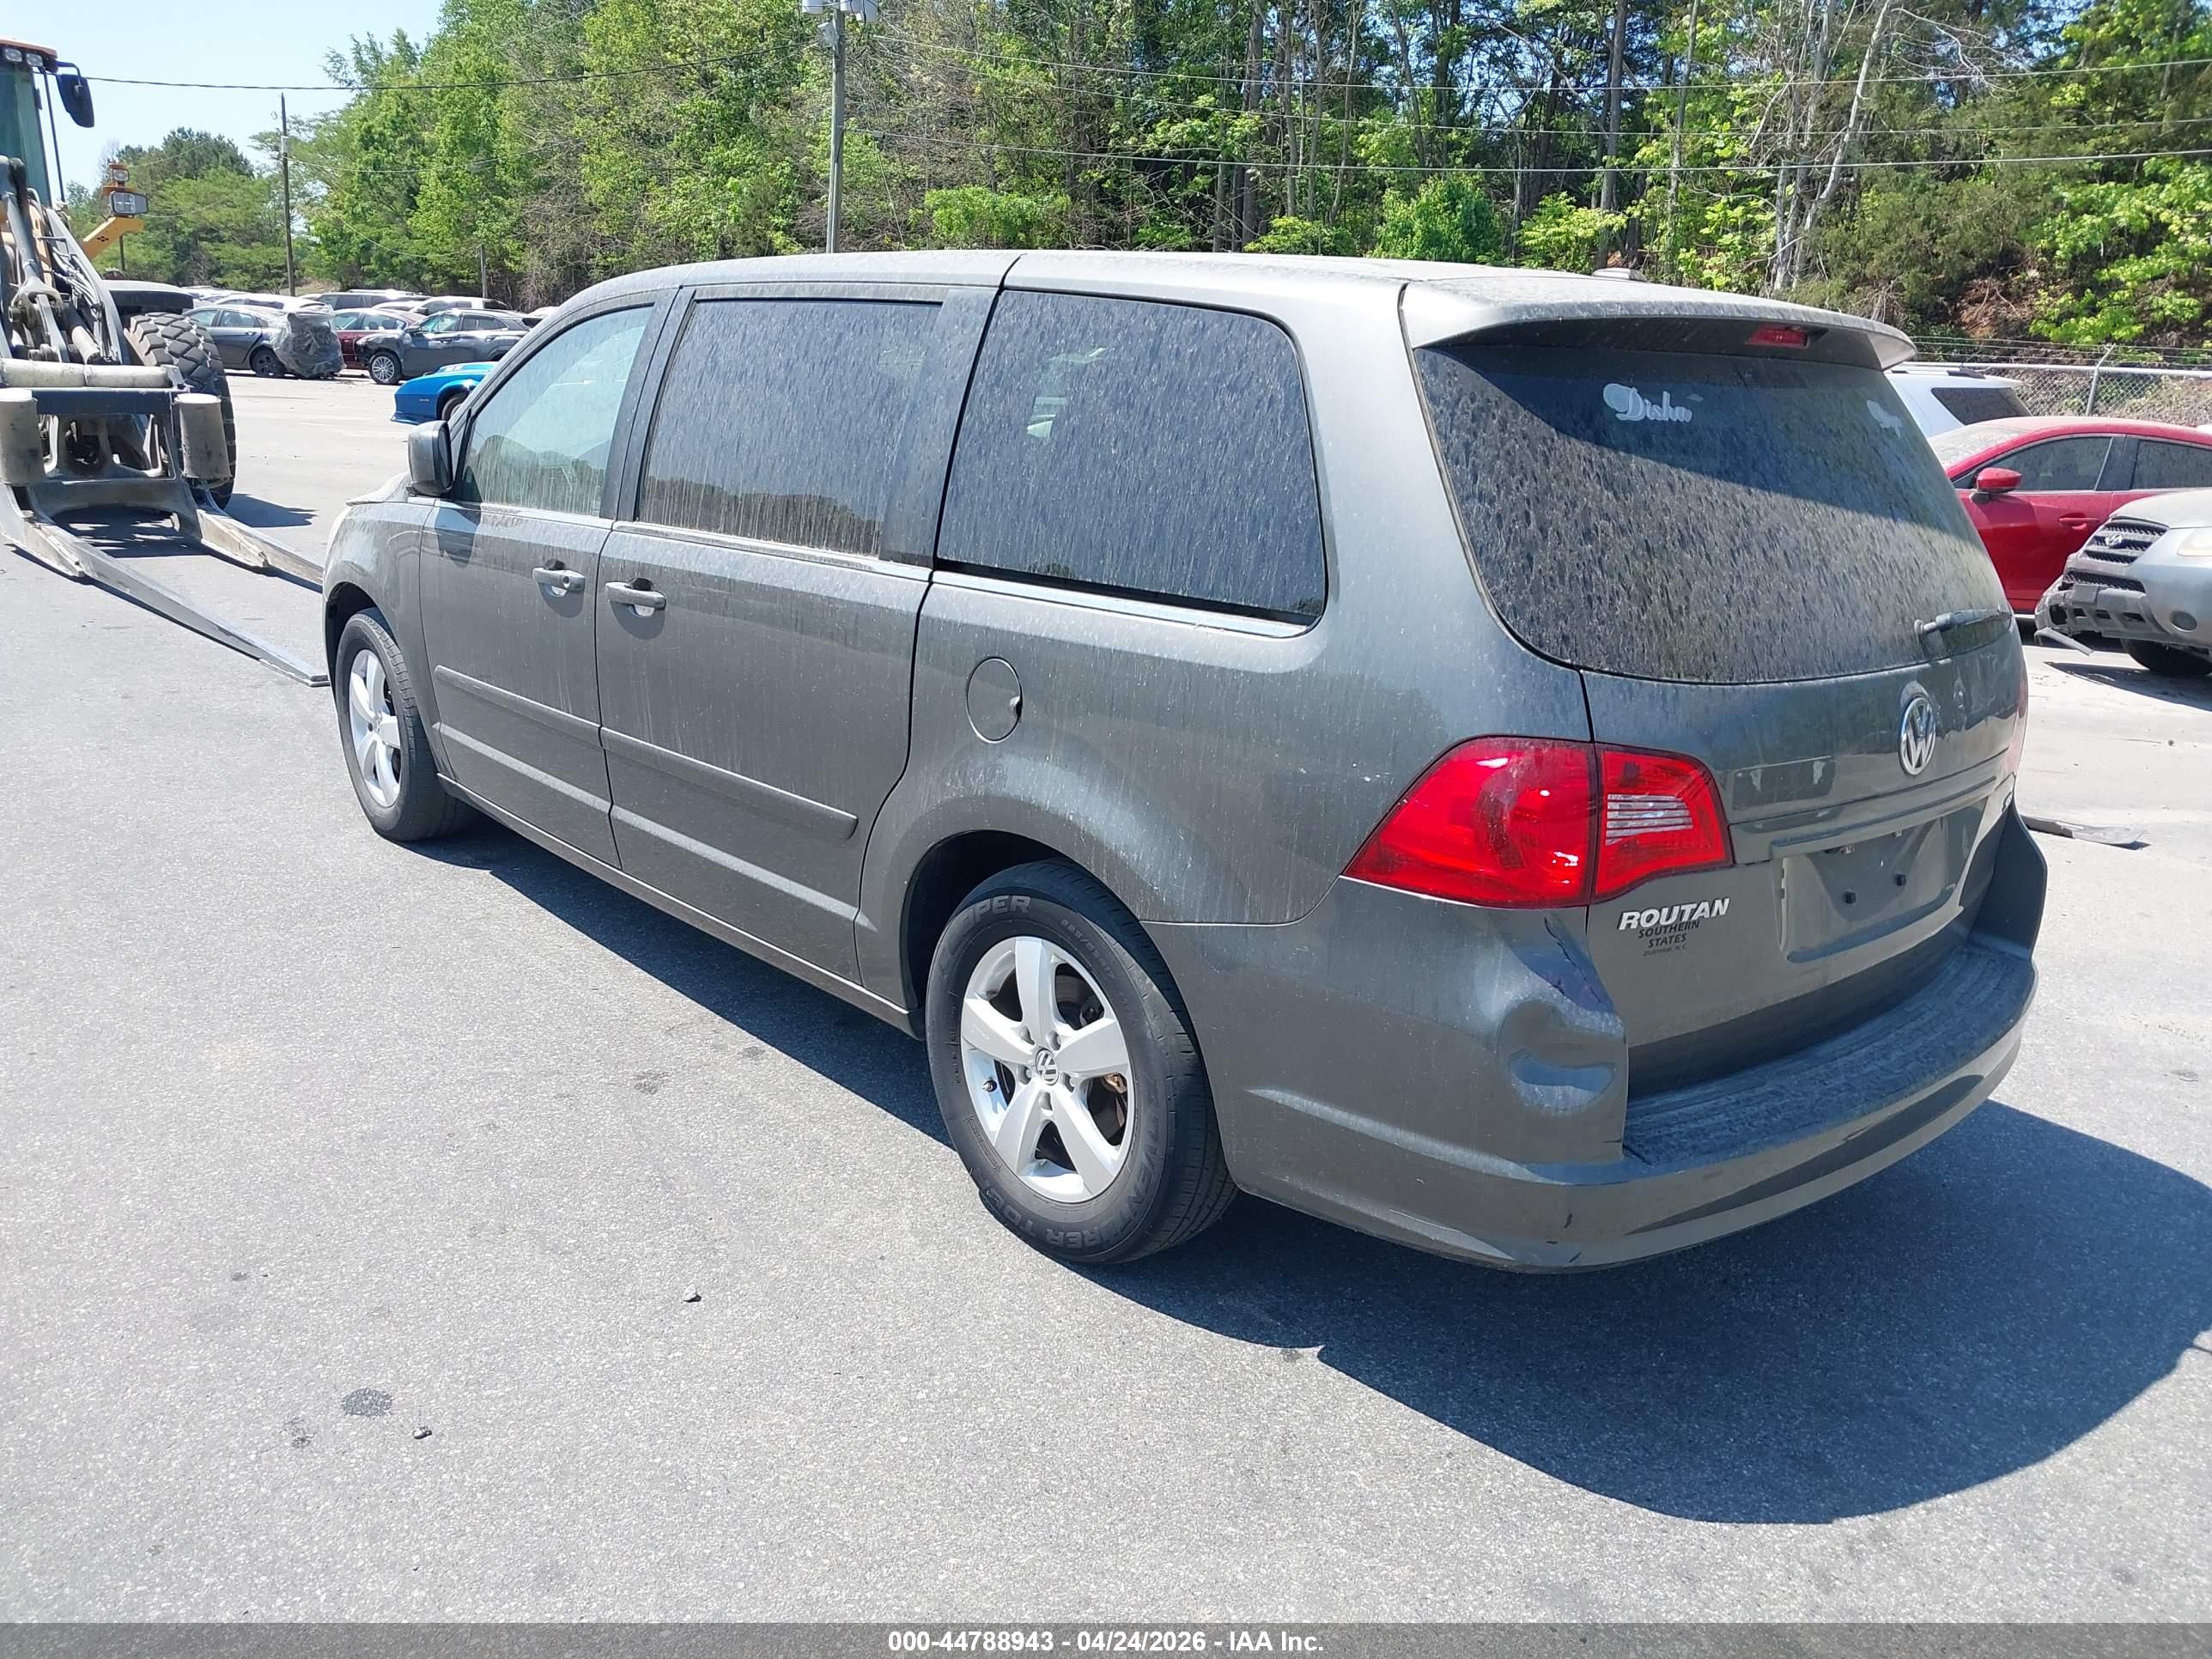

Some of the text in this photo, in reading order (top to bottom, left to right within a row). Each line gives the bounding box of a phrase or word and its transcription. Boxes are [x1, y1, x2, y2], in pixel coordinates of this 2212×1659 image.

[1617, 897, 1730, 930] ROUTAN
[1638, 921, 1700, 939] SOUTHERN
[1648, 933, 1687, 948] STATES
